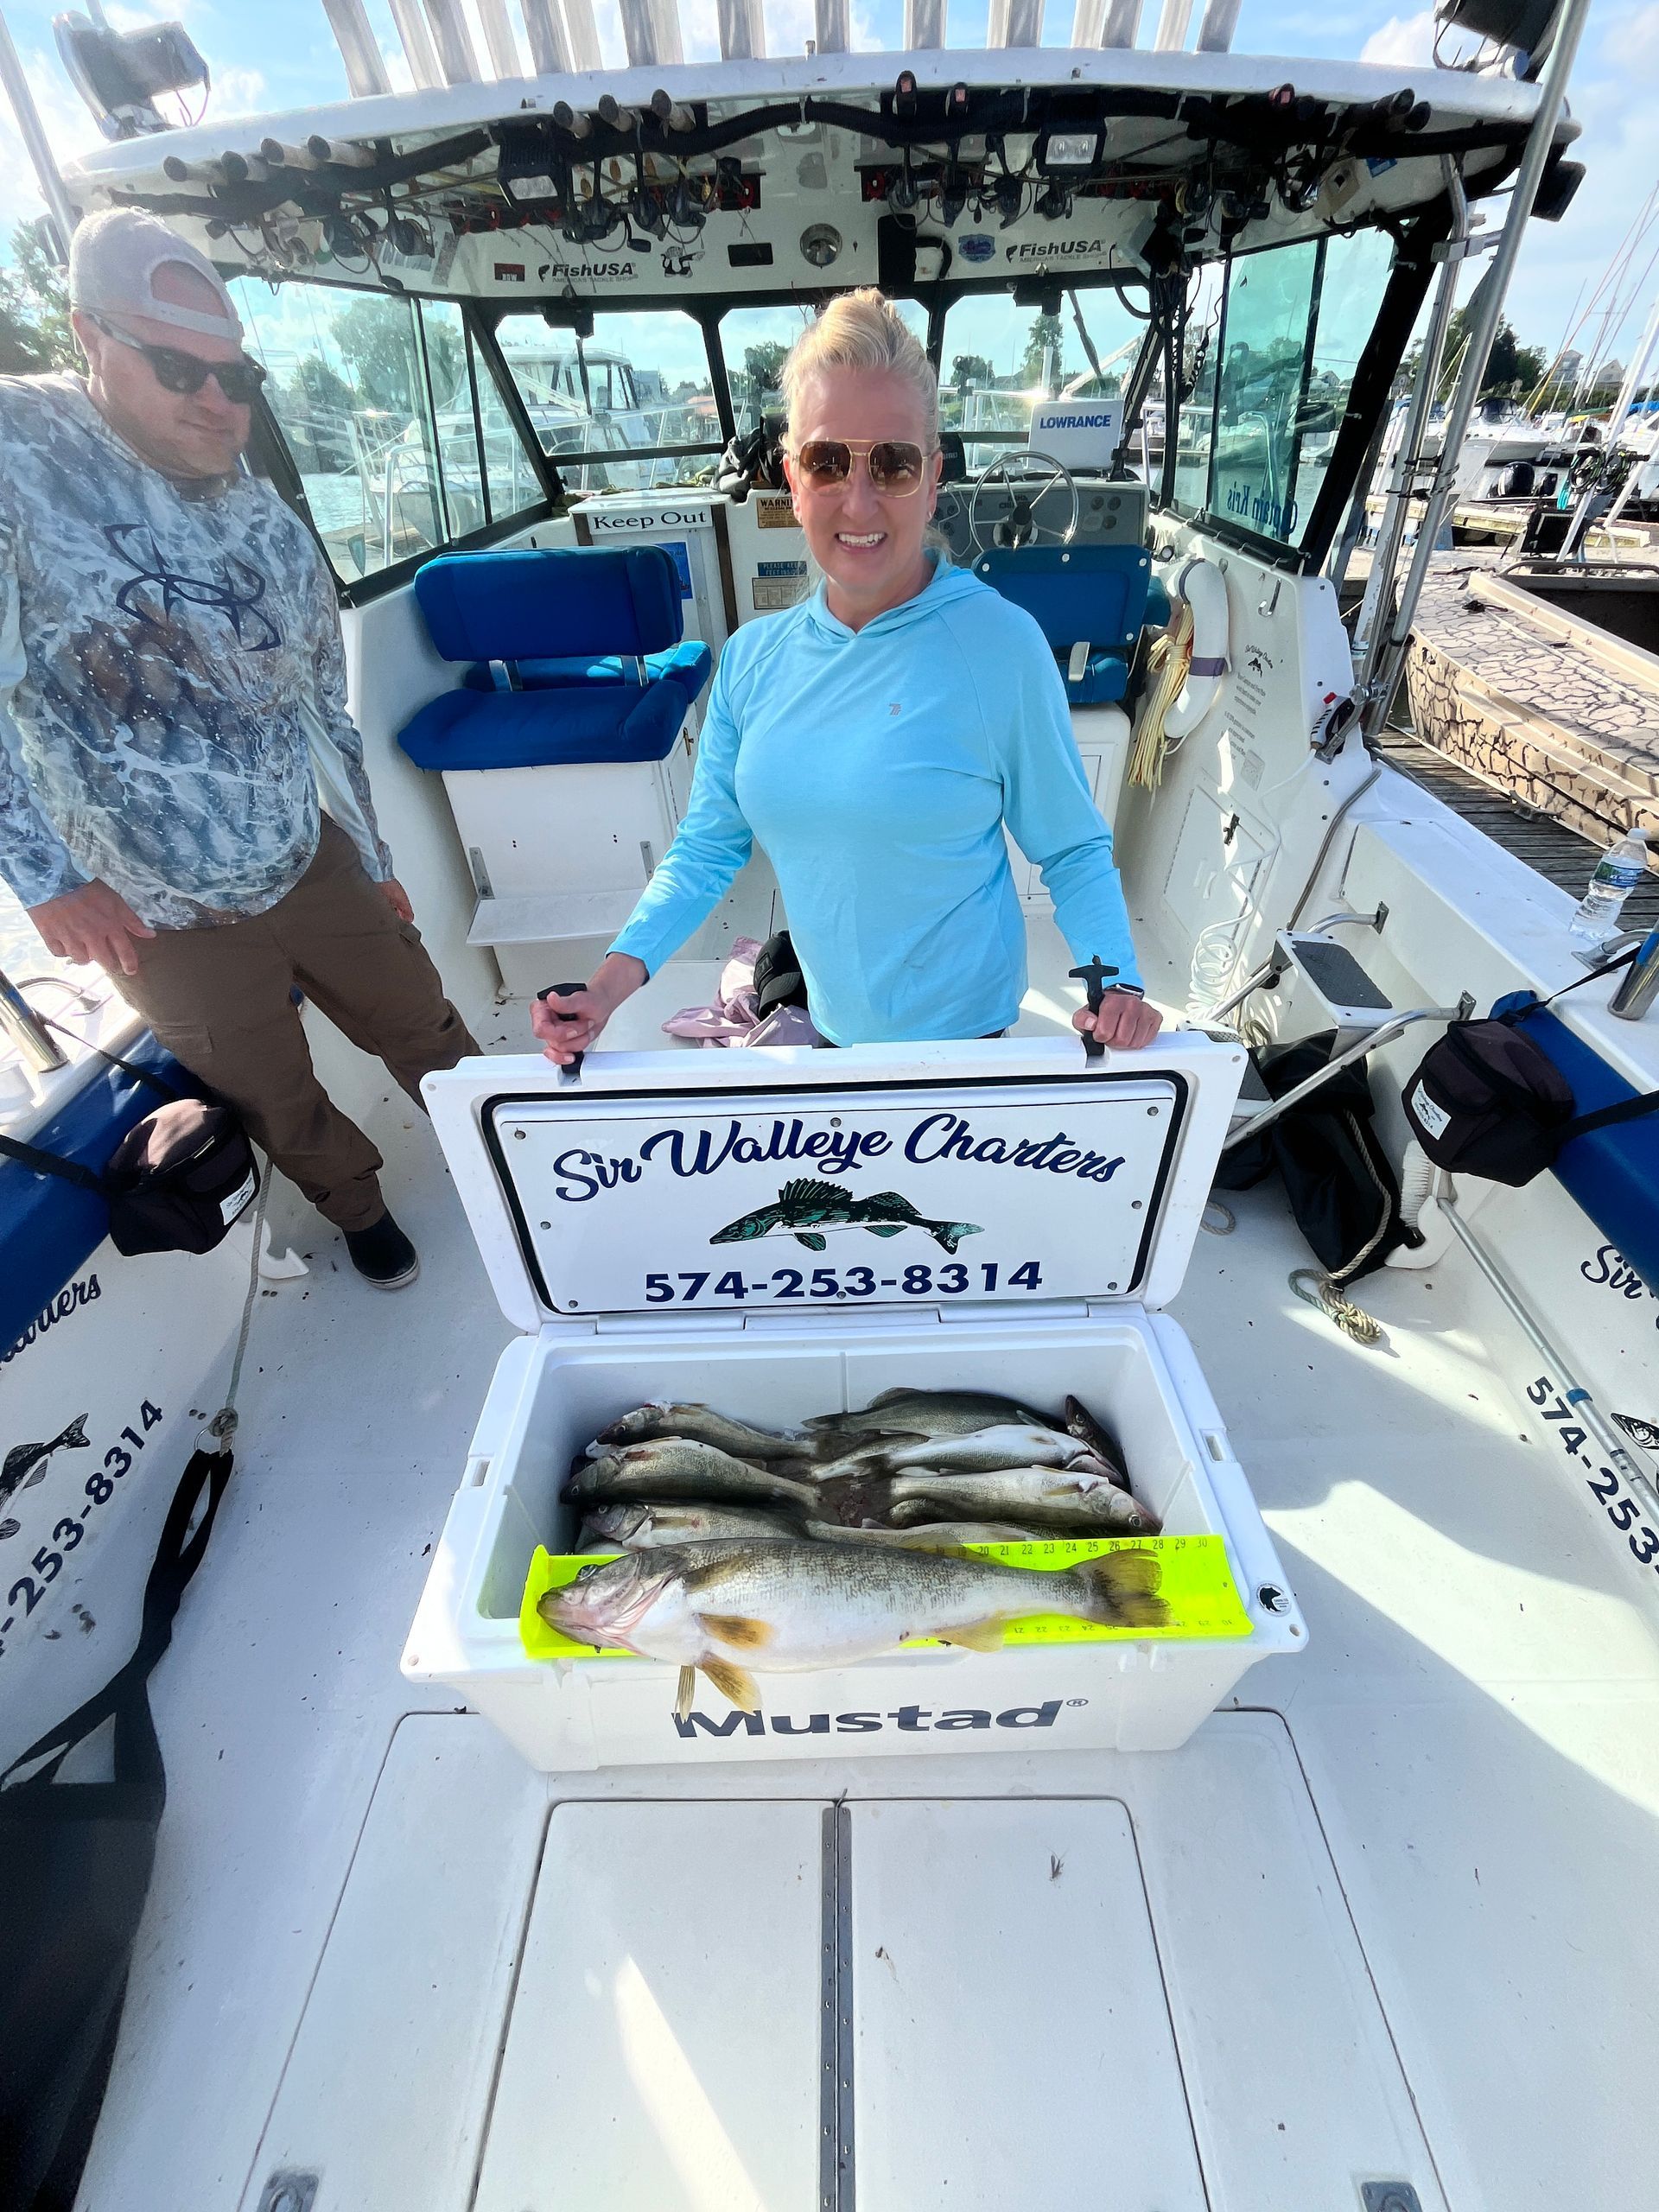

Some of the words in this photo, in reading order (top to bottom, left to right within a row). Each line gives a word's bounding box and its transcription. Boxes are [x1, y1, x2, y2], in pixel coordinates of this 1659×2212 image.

[1020, 240, 1102, 257] FishUSA
[552, 263, 633, 276] FishUSA
[1039, 415, 1112, 429] LOWRANCE
[594, 516, 654, 530] Keep
[661, 512, 706, 524] Out
[553, 1149, 642, 1202] Sir
[640, 1120, 893, 1176] Walleye
[904, 1113, 1126, 1184] Charters
[645, 1262, 1043, 1303] 574-253-8314
[1580, 1245, 1642, 1299] Sir
[1527, 1376, 1659, 1574] 574-253
[0, 1400, 162, 1657] -253-8314
[1001, 1546, 1009, 1555] 21
[1022, 1544, 1033, 1554] 22
[1044, 1543, 1055, 1554] 23
[1065, 1542, 1077, 1553] 24
[1088, 1541, 1099, 1552] 25
[1109, 1541, 1121, 1551] 26
[1131, 1540, 1141, 1549] 27
[1153, 1539, 1164, 1549] 28
[1175, 1538, 1185, 1549] 29
[1198, 1538, 1207, 1548] 30
